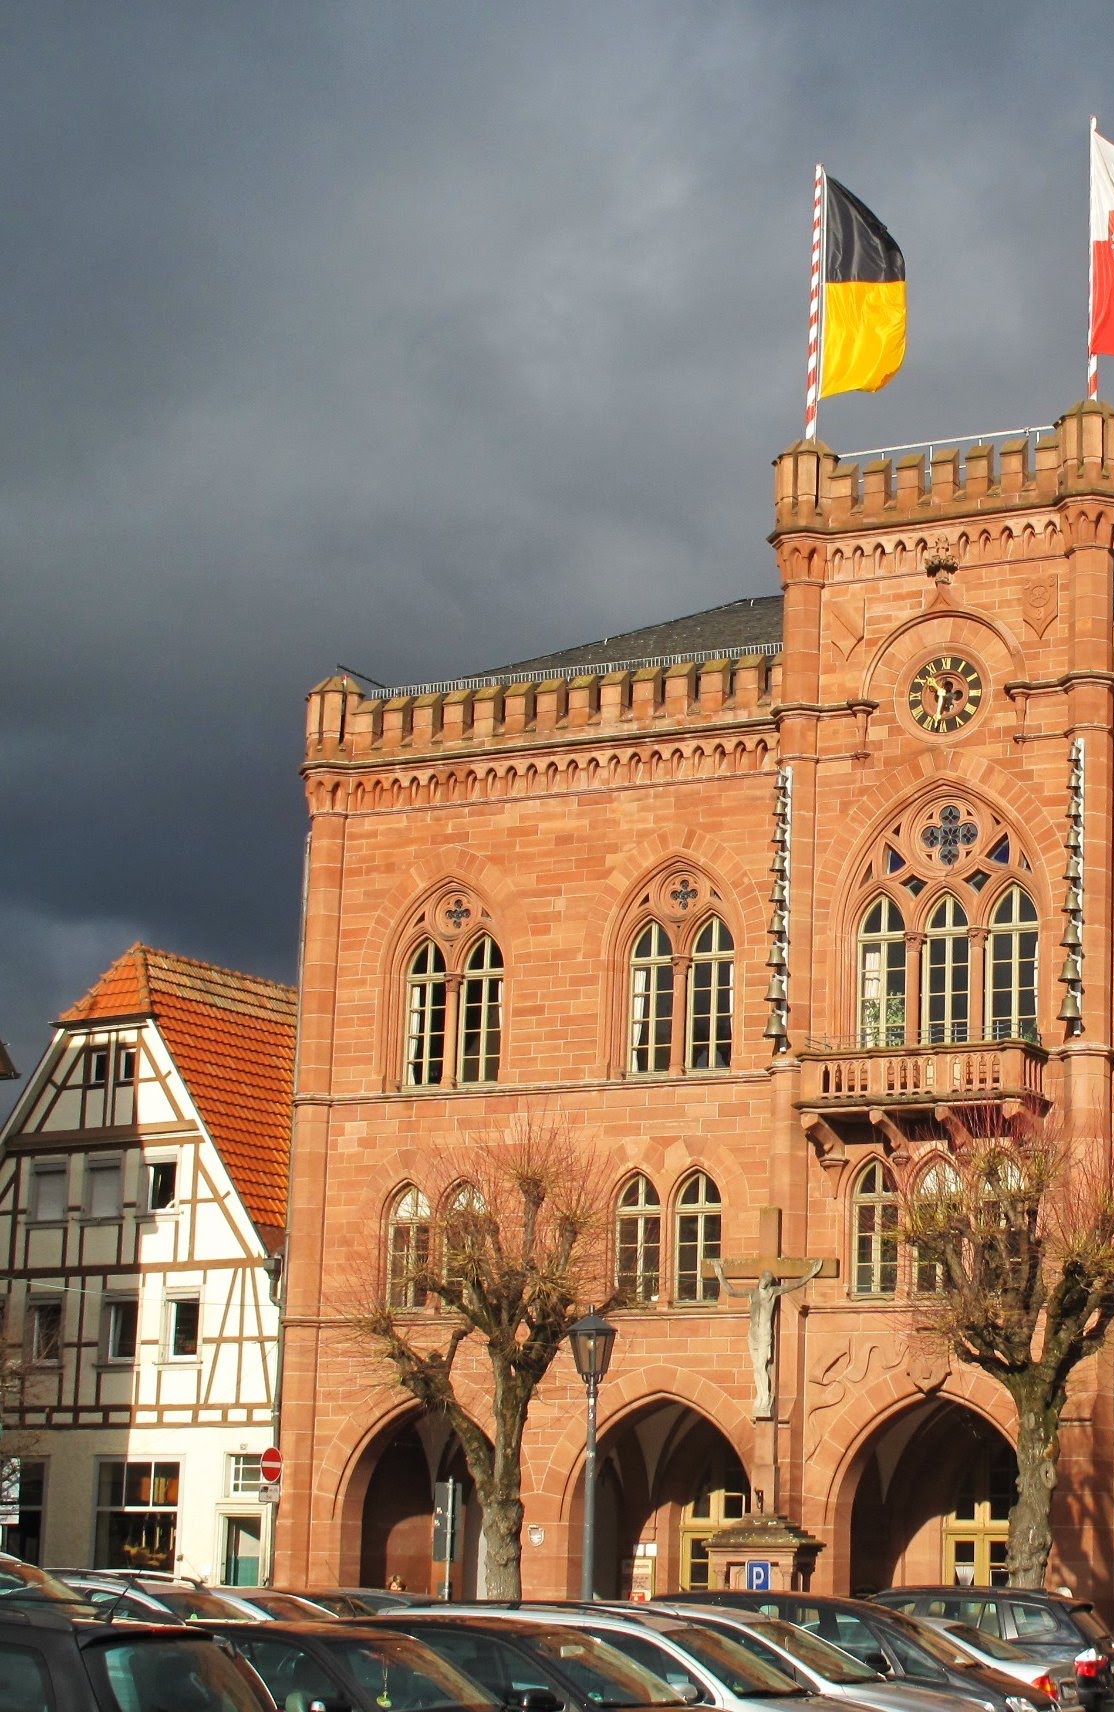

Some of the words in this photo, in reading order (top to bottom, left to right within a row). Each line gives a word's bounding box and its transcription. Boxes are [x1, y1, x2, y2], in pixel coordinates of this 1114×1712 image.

[926, 662, 937, 675] XI
[941, 657, 951, 670] XII
[914, 675, 926, 686] X
[910, 692, 921, 701] IX
[955, 716, 965, 728] V
[753, 1566, 764, 1589] P
